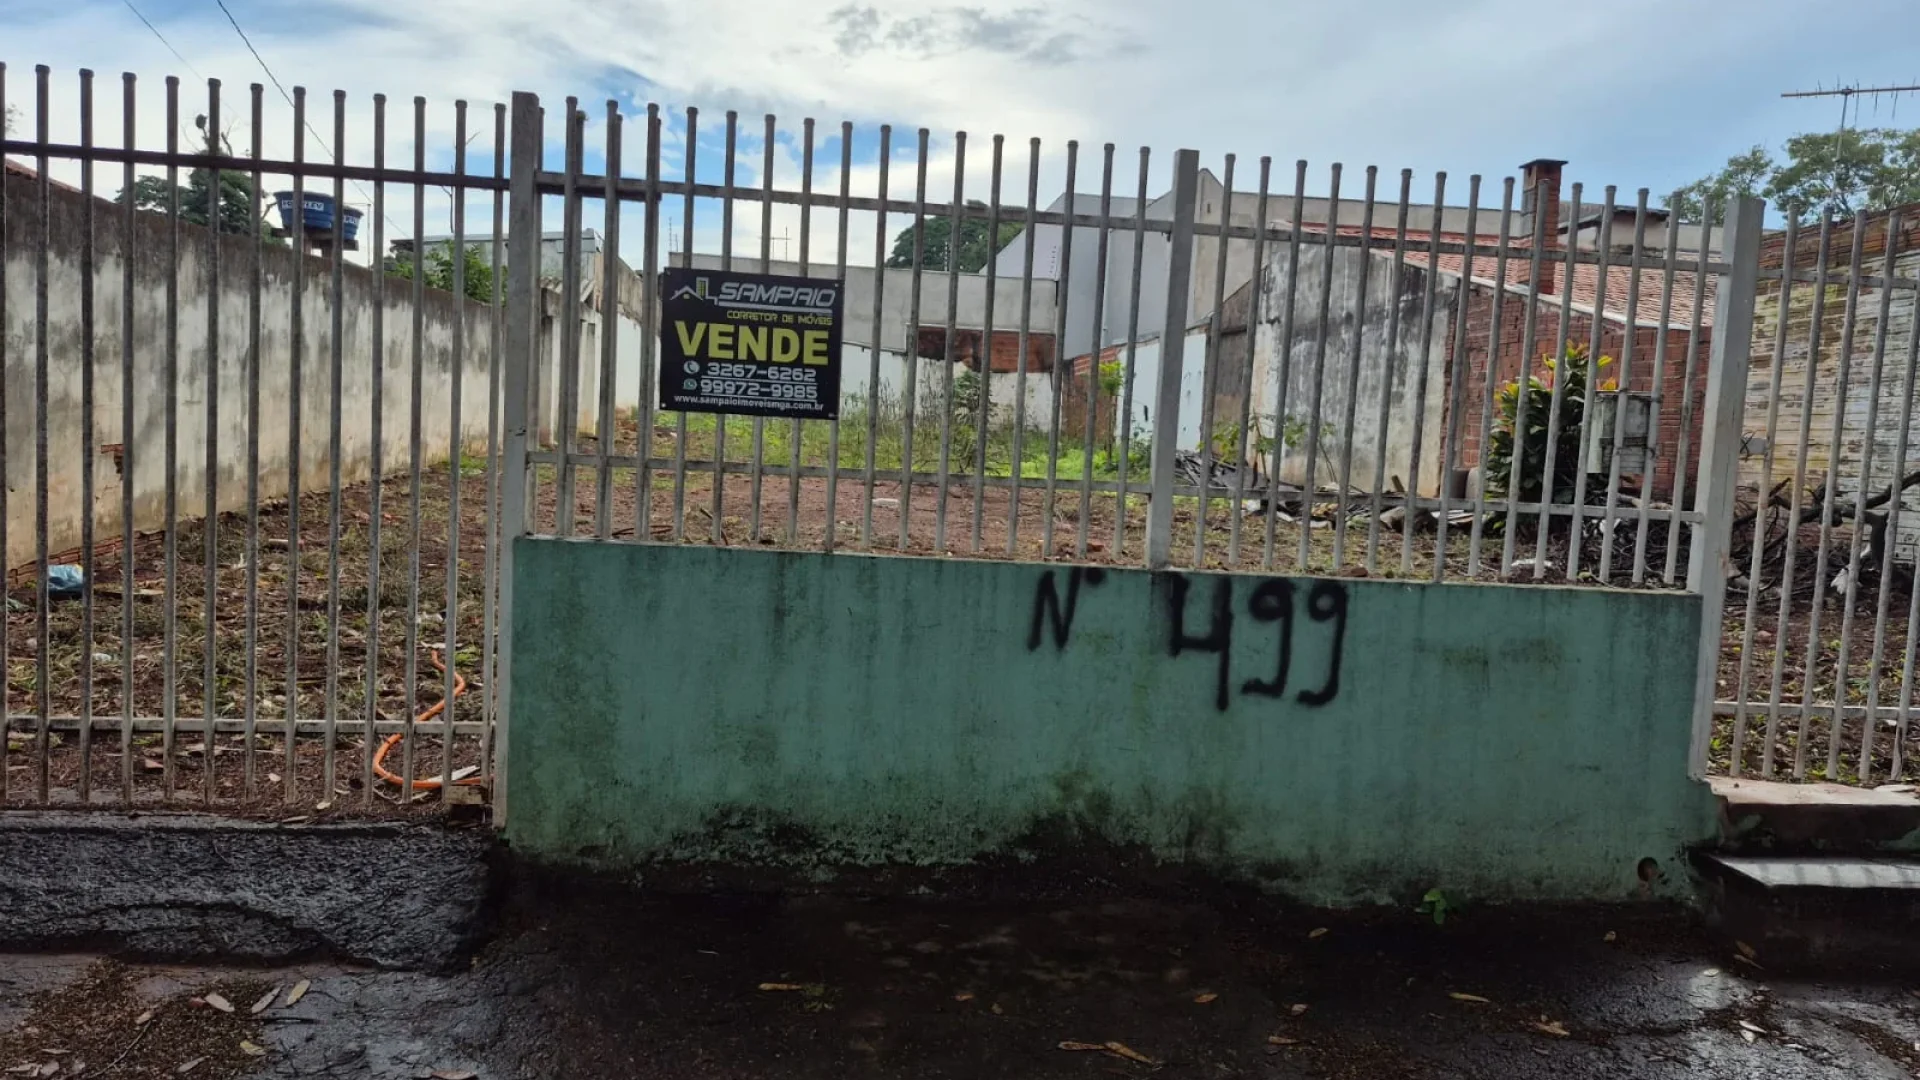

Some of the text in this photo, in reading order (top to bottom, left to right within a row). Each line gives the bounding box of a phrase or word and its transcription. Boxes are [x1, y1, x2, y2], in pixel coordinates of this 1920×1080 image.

[719, 282, 836, 307] SAMPAIO
[726, 310, 778, 323] CORRETOR
[782, 315, 794, 323] DE
[674, 320, 829, 365] VENDE
[707, 362, 817, 382] 3267-6262
[700, 379, 818, 399] 99972-9985
[674, 395, 824, 411] www.sampaioimoveismga.com.br
[1167, 570, 1348, 712] 499
